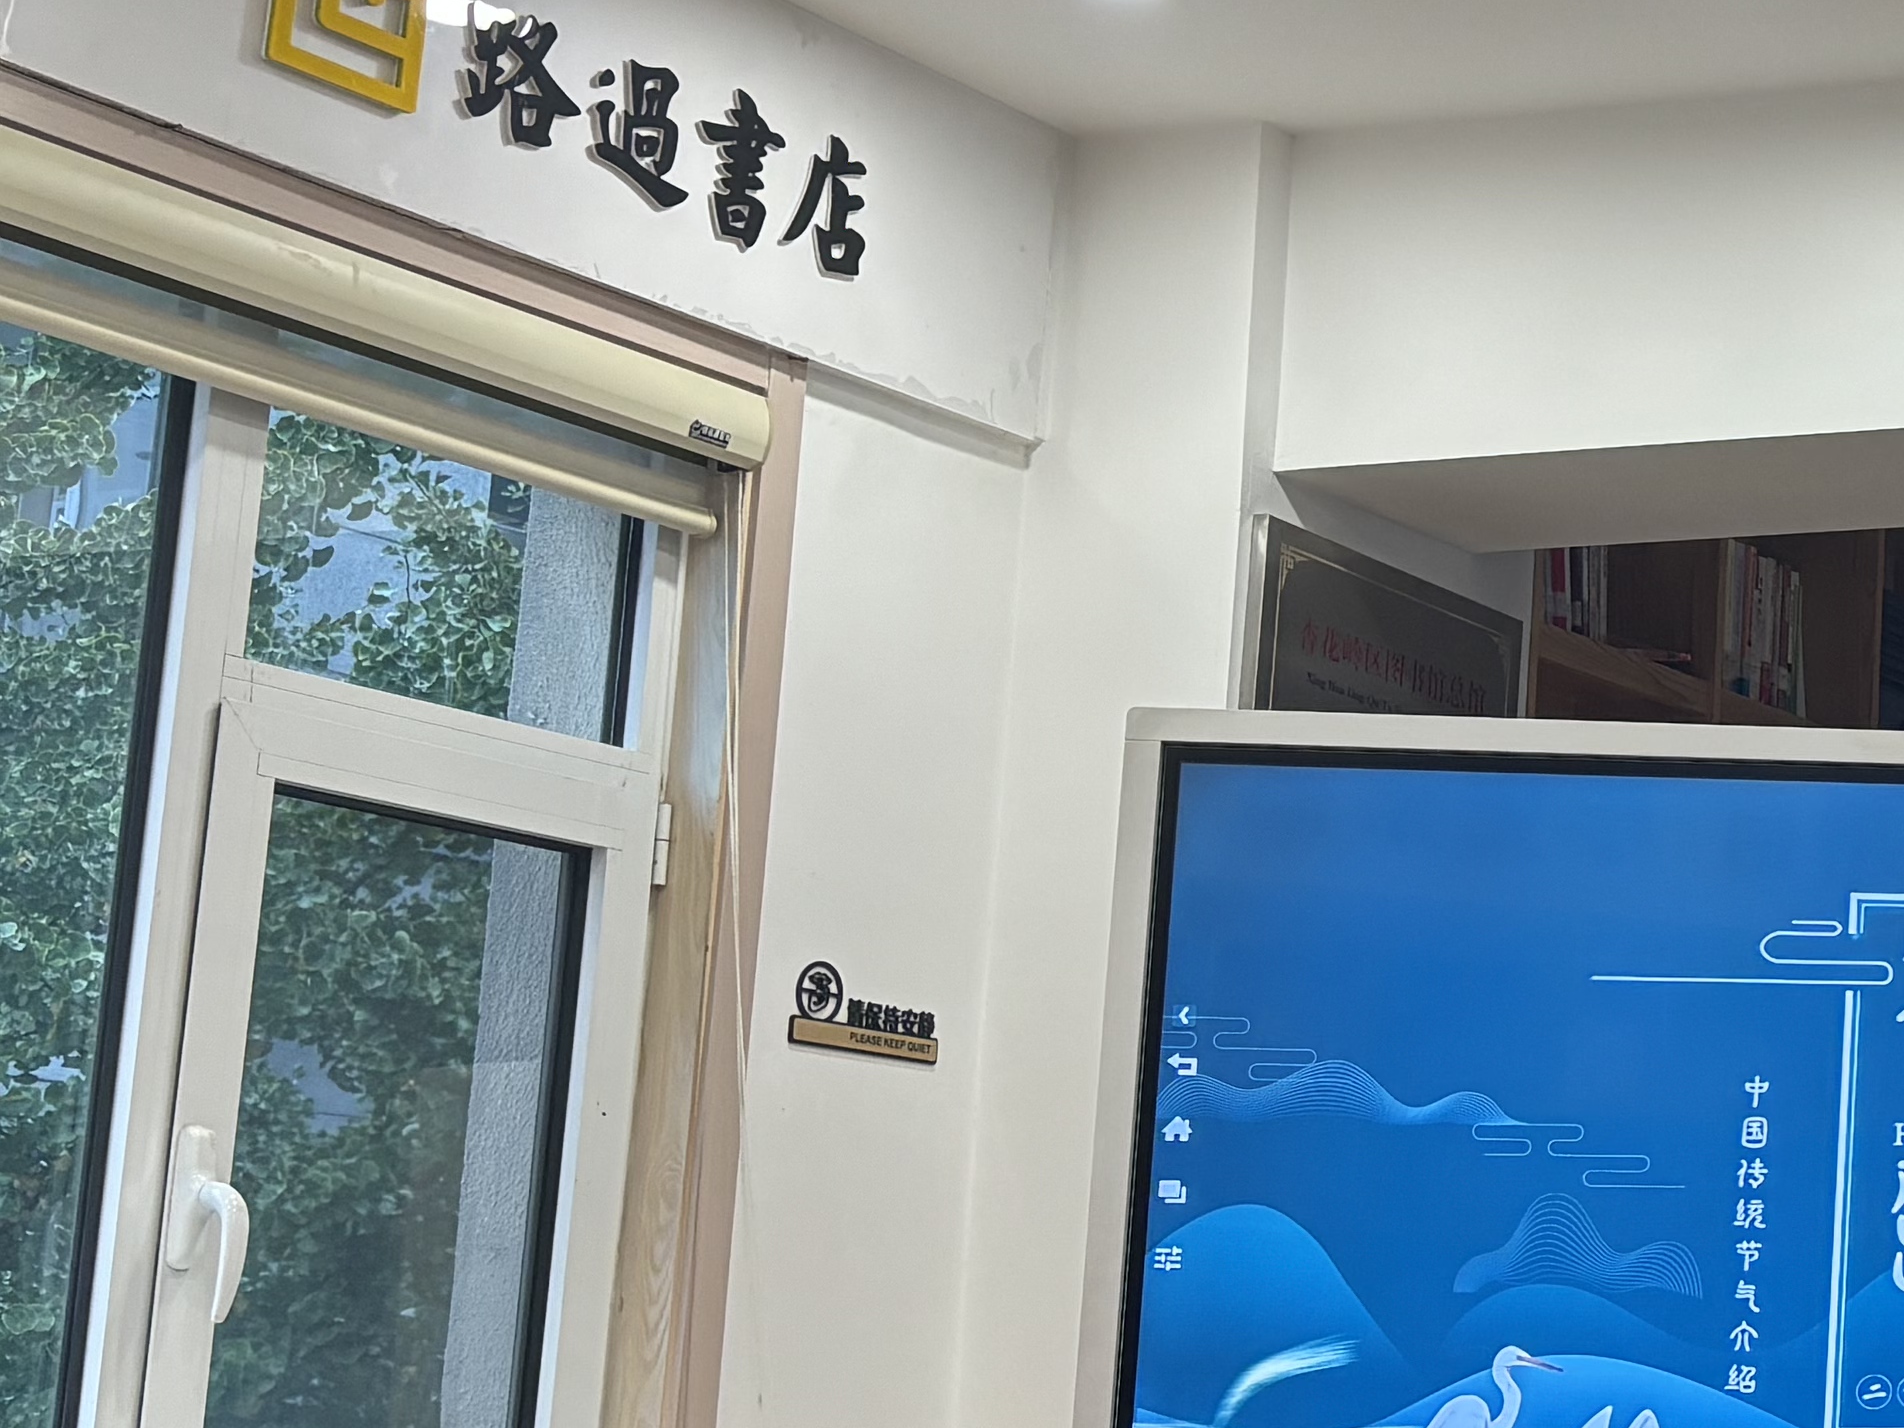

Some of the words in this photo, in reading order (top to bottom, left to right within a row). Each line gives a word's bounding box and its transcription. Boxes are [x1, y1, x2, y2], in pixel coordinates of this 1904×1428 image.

[456, 2, 867, 280] 路過書店
[849, 1031, 883, 1047] PLEASE
[884, 1038, 906, 1050] KEEP
[907, 1041, 931, 1054] QUIET
[1723, 1074, 1770, 1394] 中国传统节气介绍
